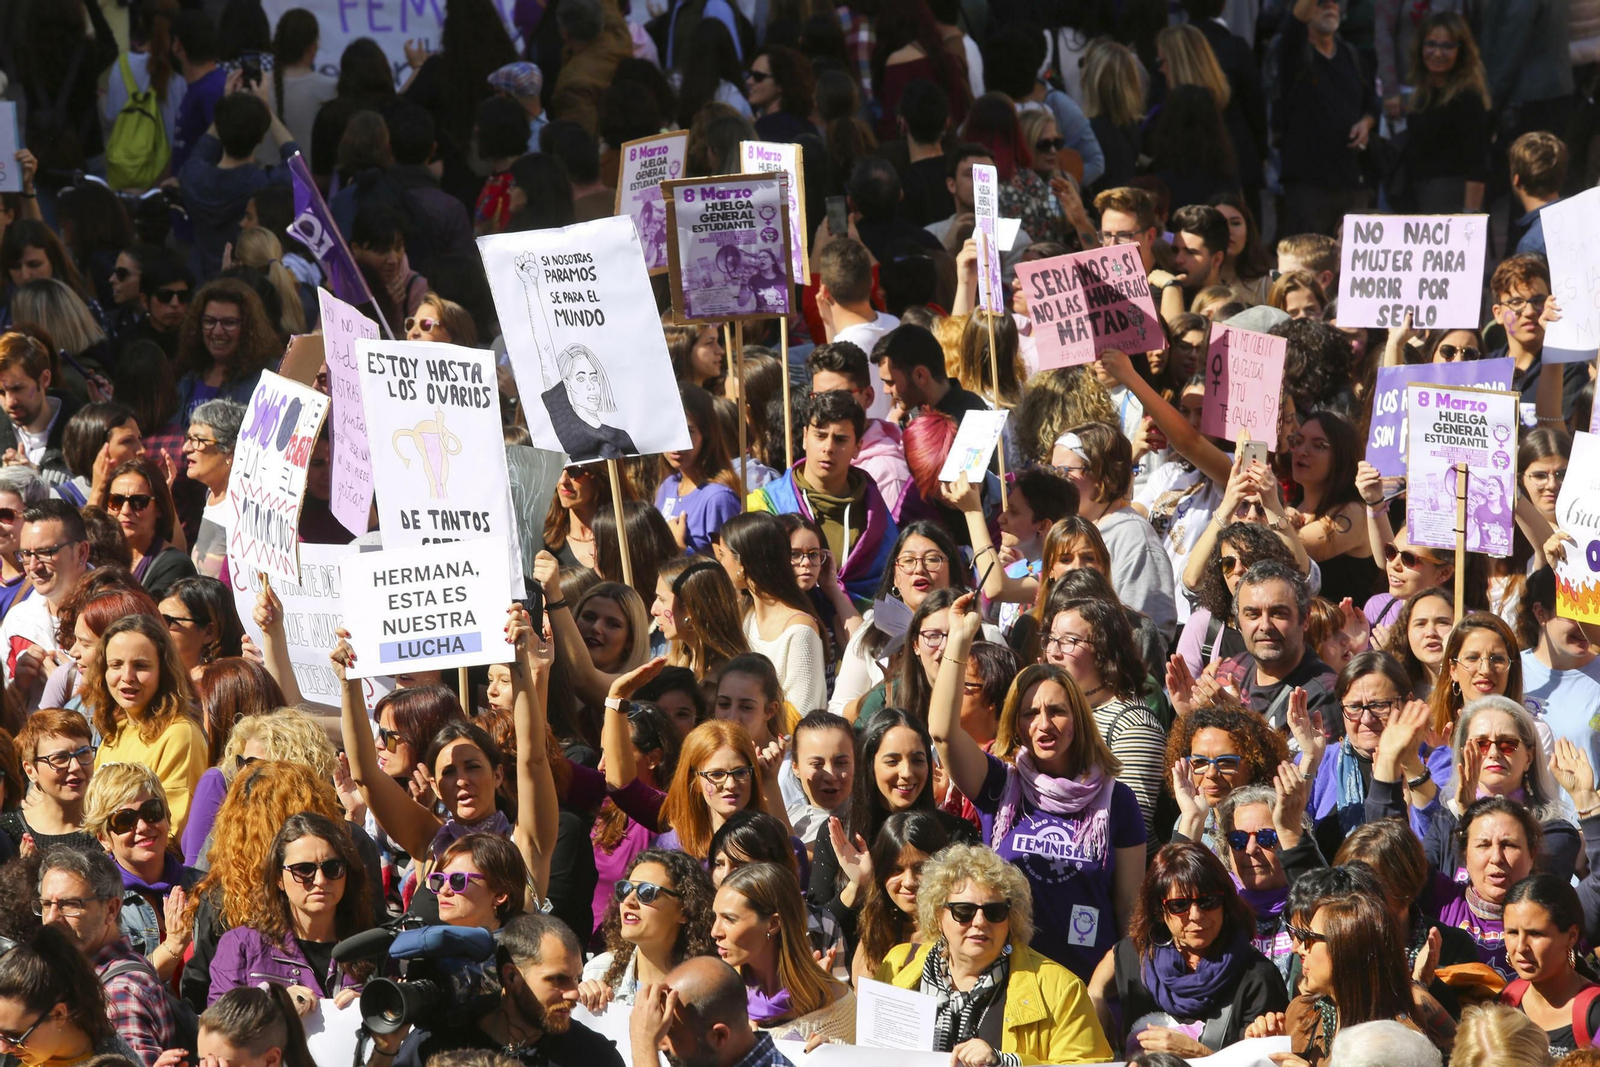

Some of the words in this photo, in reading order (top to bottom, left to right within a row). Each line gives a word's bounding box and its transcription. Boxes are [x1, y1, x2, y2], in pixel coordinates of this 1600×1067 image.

[630, 148, 636, 161] 8
[640, 145, 668, 159] Marzo
[640, 156, 668, 170] HUELGA
[748, 145, 754, 159] 8
[756, 146, 782, 162] Marzo
[636, 166, 667, 181] GENERAL
[683, 188, 695, 202] 8
[700, 186, 752, 200] Marzo
[700, 210, 755, 223] GENERAL
[705, 200, 754, 212] HUELGA
[692, 220, 756, 233] ESTUDIANTIL
[1353, 221, 1384, 244] NO
[1403, 218, 1452, 245] NACÍ
[541, 256, 550, 266] SI
[552, 252, 594, 266] NOSOTRAS
[1351, 248, 1413, 272] MUJER
[1422, 250, 1466, 272] PARA
[1030, 255, 1110, 300] SERÍAMOS
[1350, 276, 1402, 300] MORIR
[1418, 277, 1450, 300] POR
[550, 291, 562, 304] SE
[562, 291, 585, 303] PARA
[587, 290, 600, 302] EL
[554, 308, 606, 327] MUNDO
[1032, 301, 1054, 324] NO
[1055, 294, 1084, 318] LAS
[342, 318, 354, 333] NO
[1222, 329, 1238, 348] EN
[1240, 332, 1250, 352] MI
[368, 352, 418, 378] ESTOY
[426, 359, 483, 384] HASTA
[387, 379, 417, 401] LOS
[426, 382, 491, 408] OVARIOS
[1376, 388, 1399, 416] LOS
[1418, 391, 1430, 407] 8
[1436, 392, 1488, 413] Marzo
[1220, 403, 1229, 424] TE
[1232, 406, 1258, 428] CALLAS
[1439, 410, 1488, 426] HUELGA
[1372, 425, 1396, 449] SON
[1424, 434, 1489, 448] ESTUDIANTIL
[1432, 422, 1489, 438] GENERAL
[400, 510, 421, 530] DE
[428, 509, 490, 532] TANTOS
[373, 560, 480, 588] HERMANA,
[388, 590, 438, 610] ESTA
[442, 586, 468, 604] ES
[383, 610, 477, 636] NUESTRA
[397, 636, 466, 660] LUCHA
[1062, 822, 1074, 831] 10
